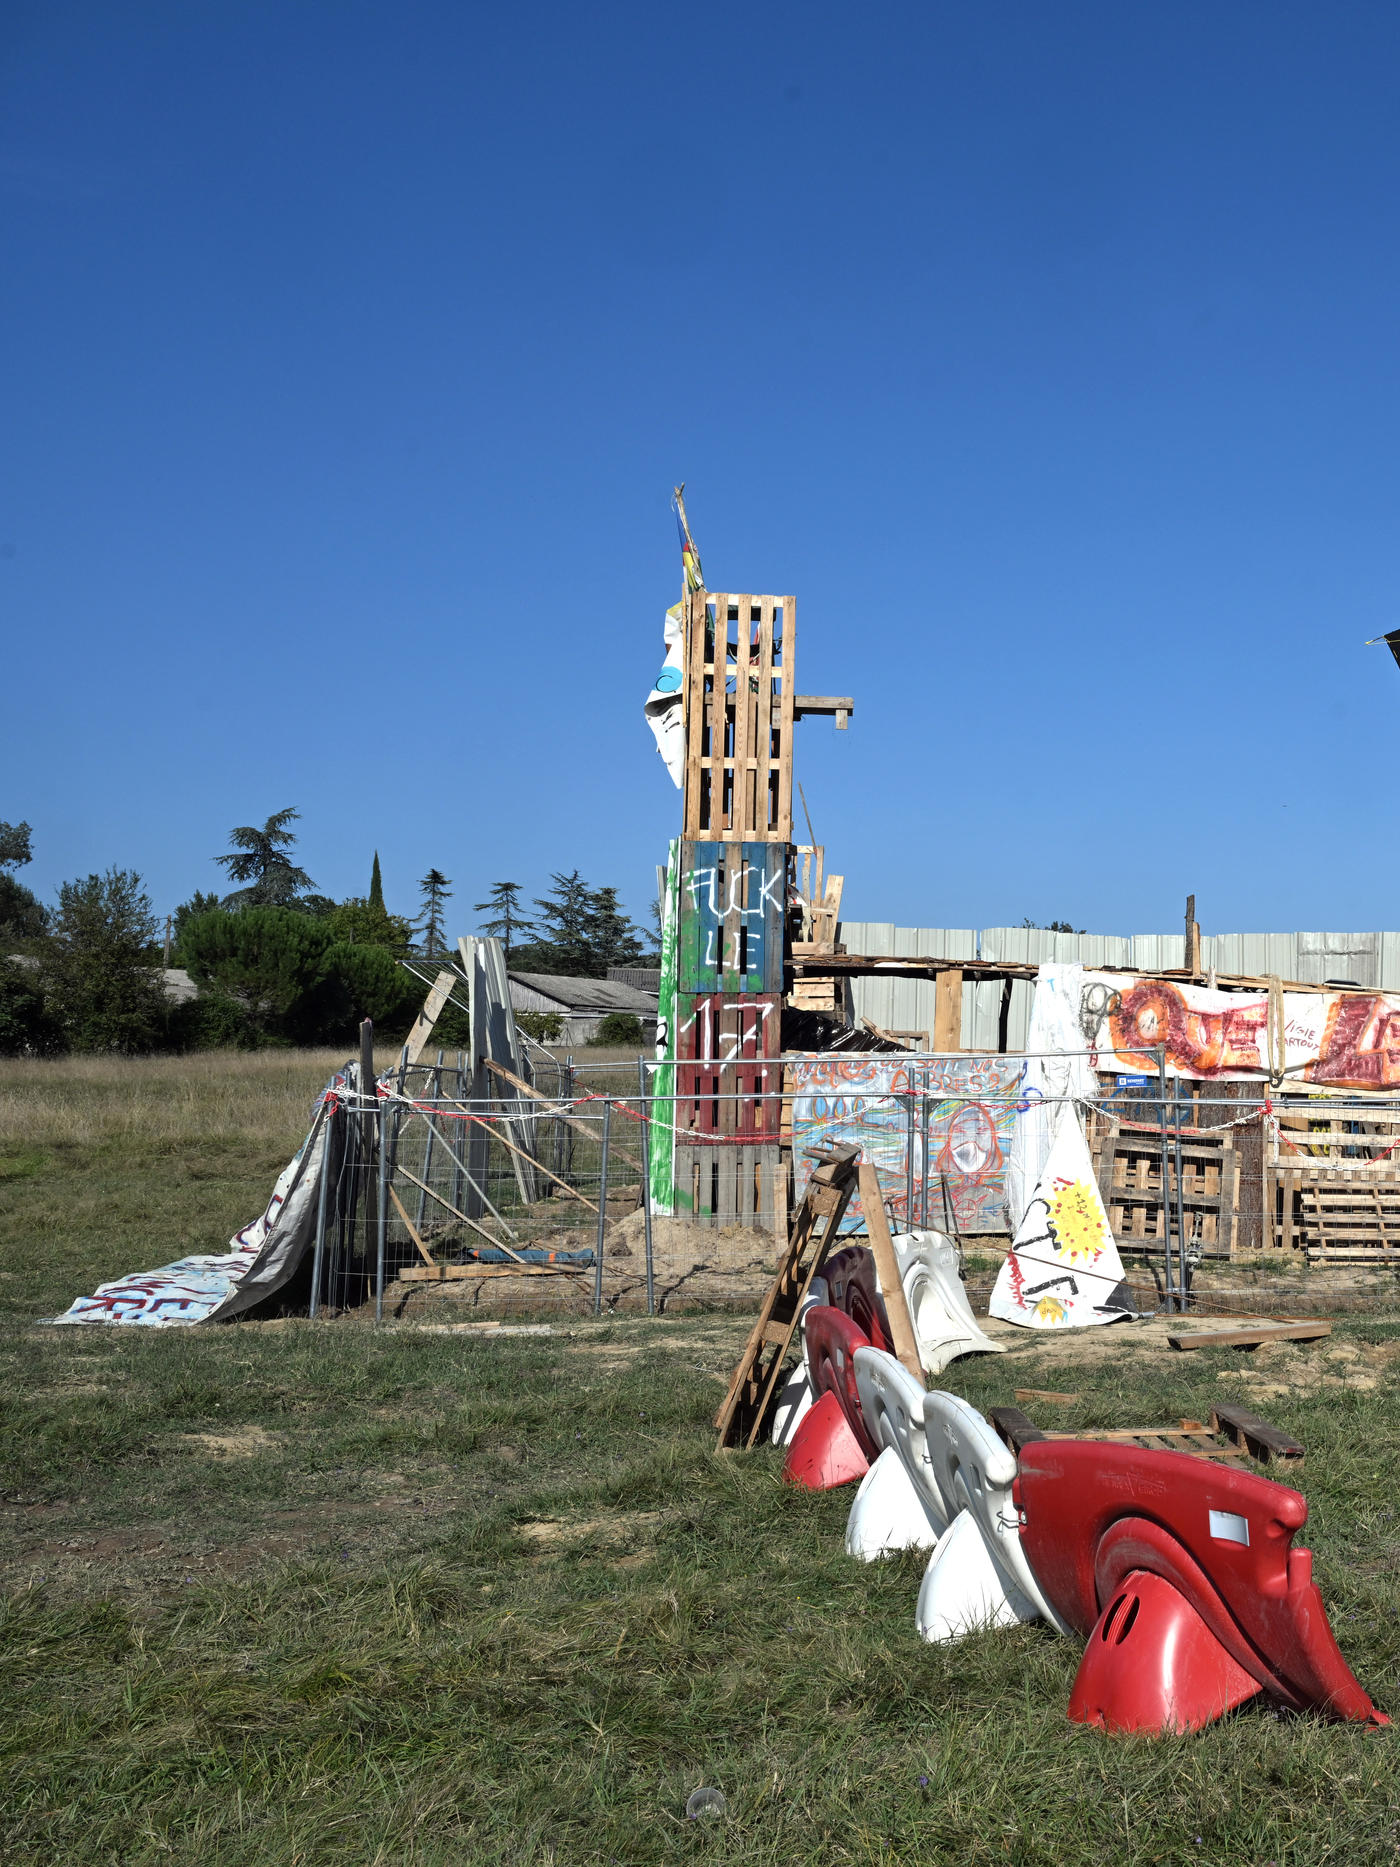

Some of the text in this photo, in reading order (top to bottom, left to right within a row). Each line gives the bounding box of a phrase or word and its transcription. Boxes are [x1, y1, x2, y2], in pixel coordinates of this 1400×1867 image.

[682, 867, 783, 918] FUCK
[706, 931, 761, 969] LE
[1109, 979, 1269, 1077] QUE
[971, 1058, 1009, 1073] NOS
